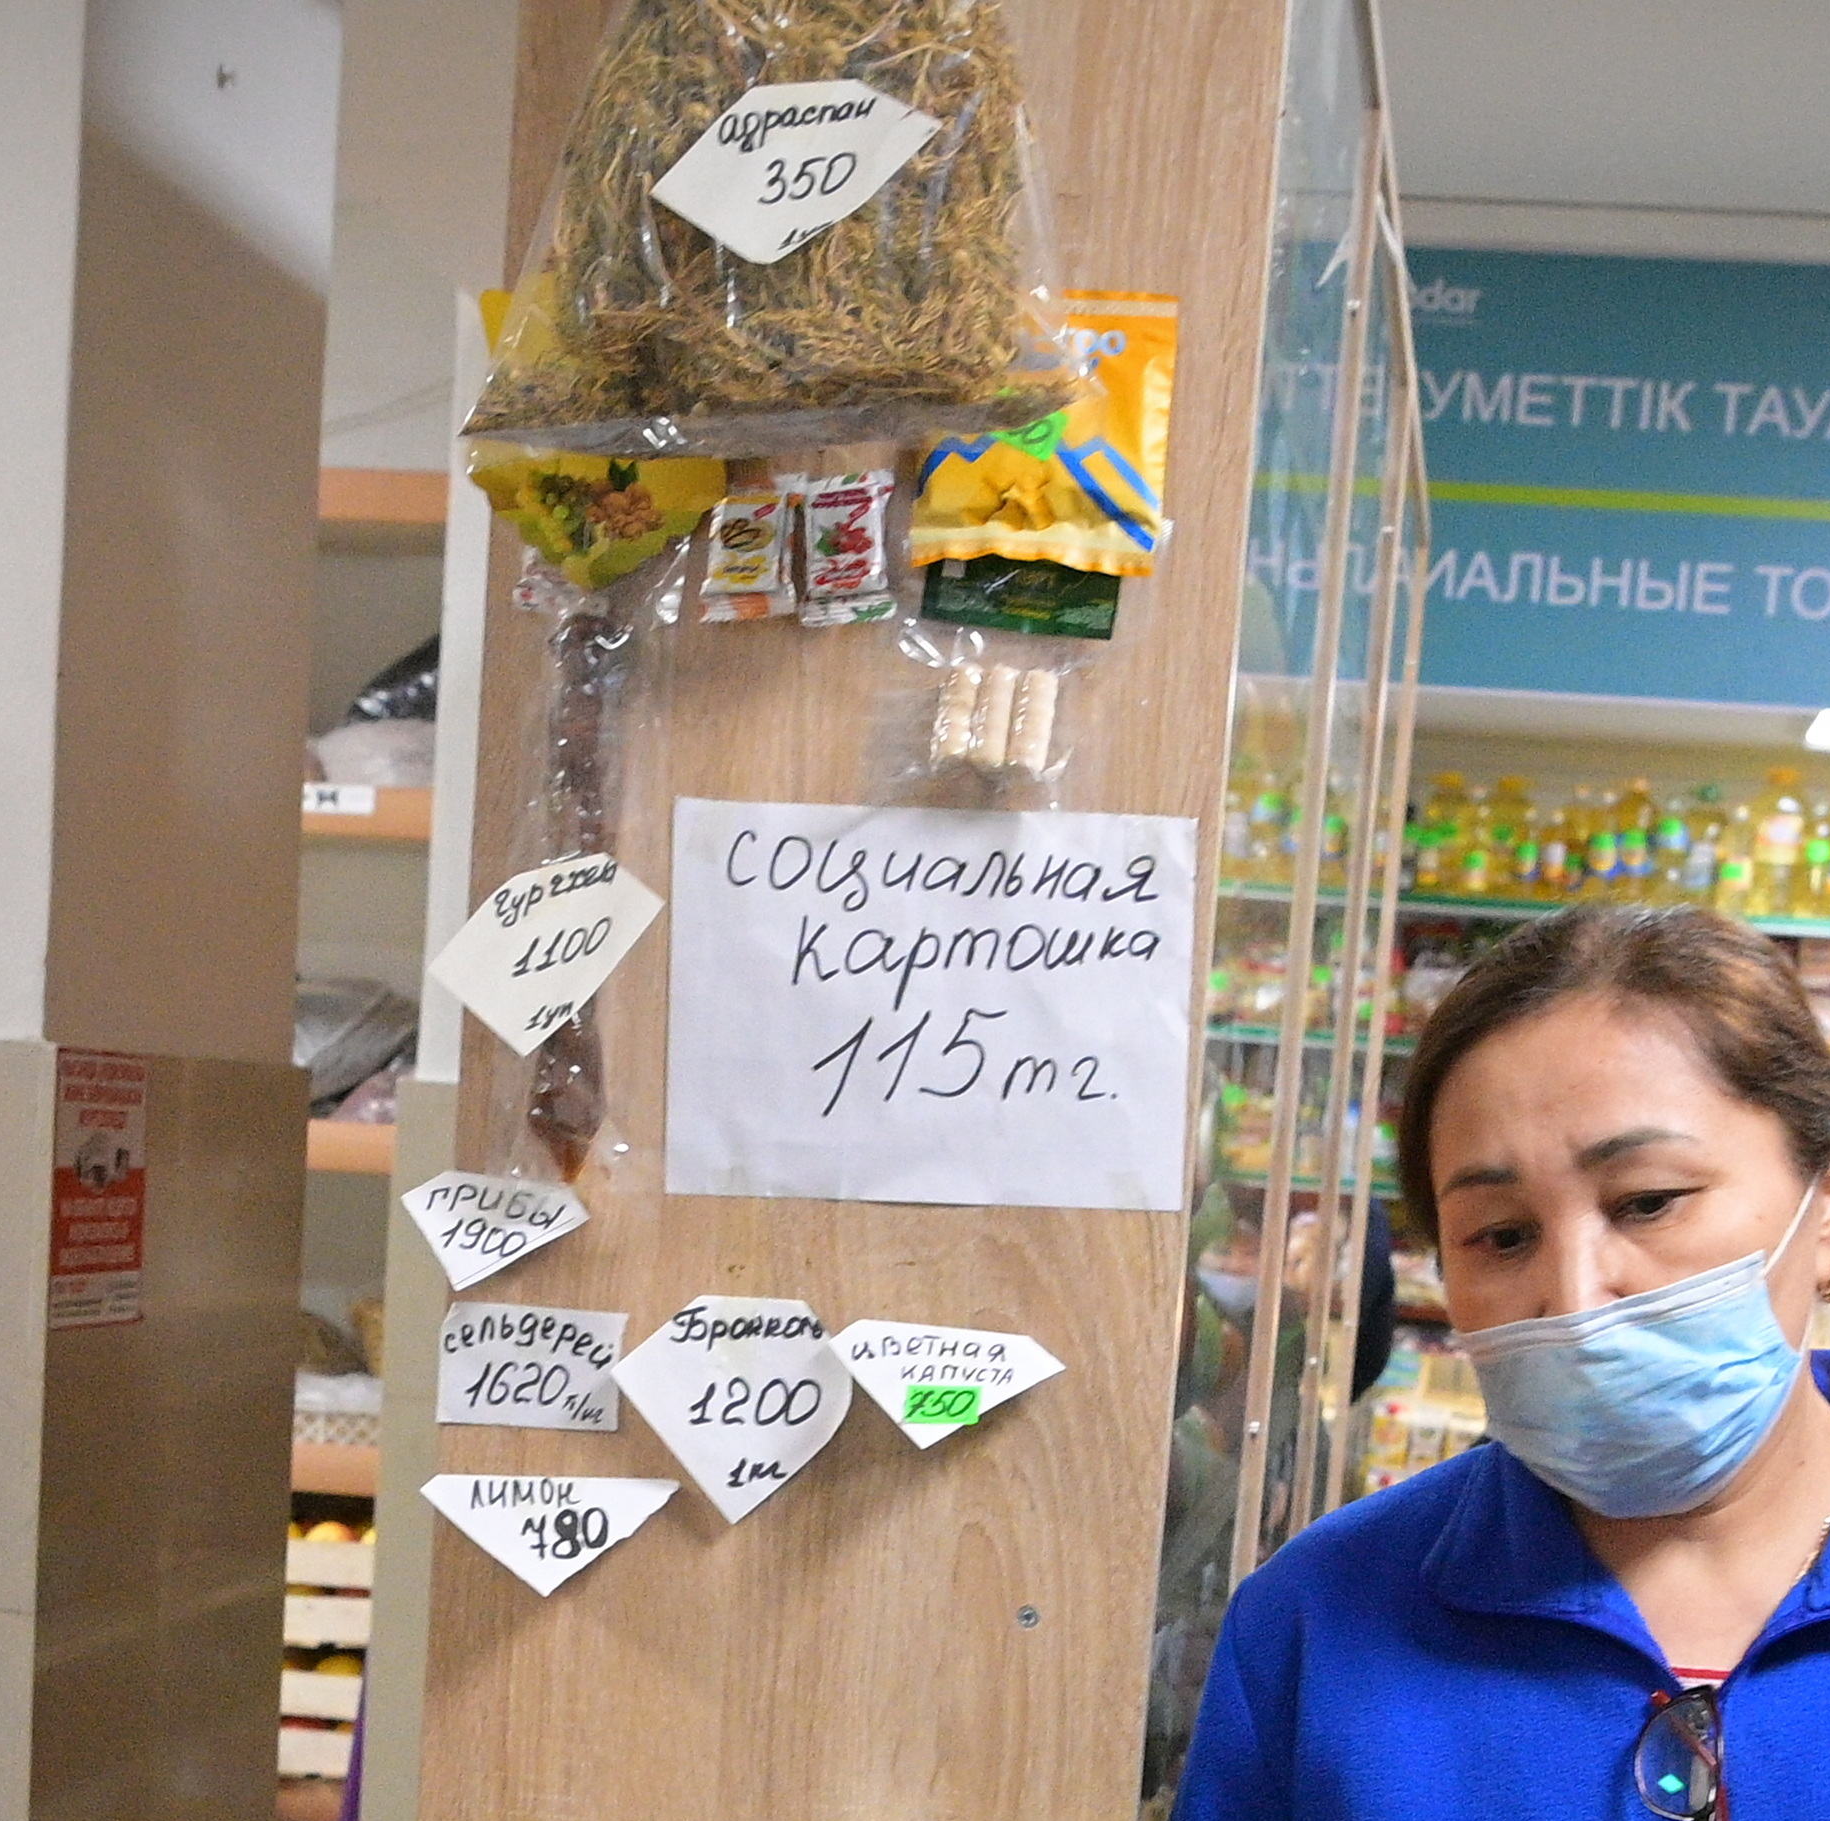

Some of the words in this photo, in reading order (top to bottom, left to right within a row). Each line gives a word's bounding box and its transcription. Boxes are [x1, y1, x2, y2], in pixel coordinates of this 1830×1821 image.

[758, 151, 857, 205] 350
[1406, 278, 1482, 313] dar
[510, 915, 613, 977] 1100
[439, 1217, 528, 1258] 1900
[688, 1376, 822, 1427] 1200
[906, 1390, 977, 1419] 750
[521, 1506, 610, 1561] 780
